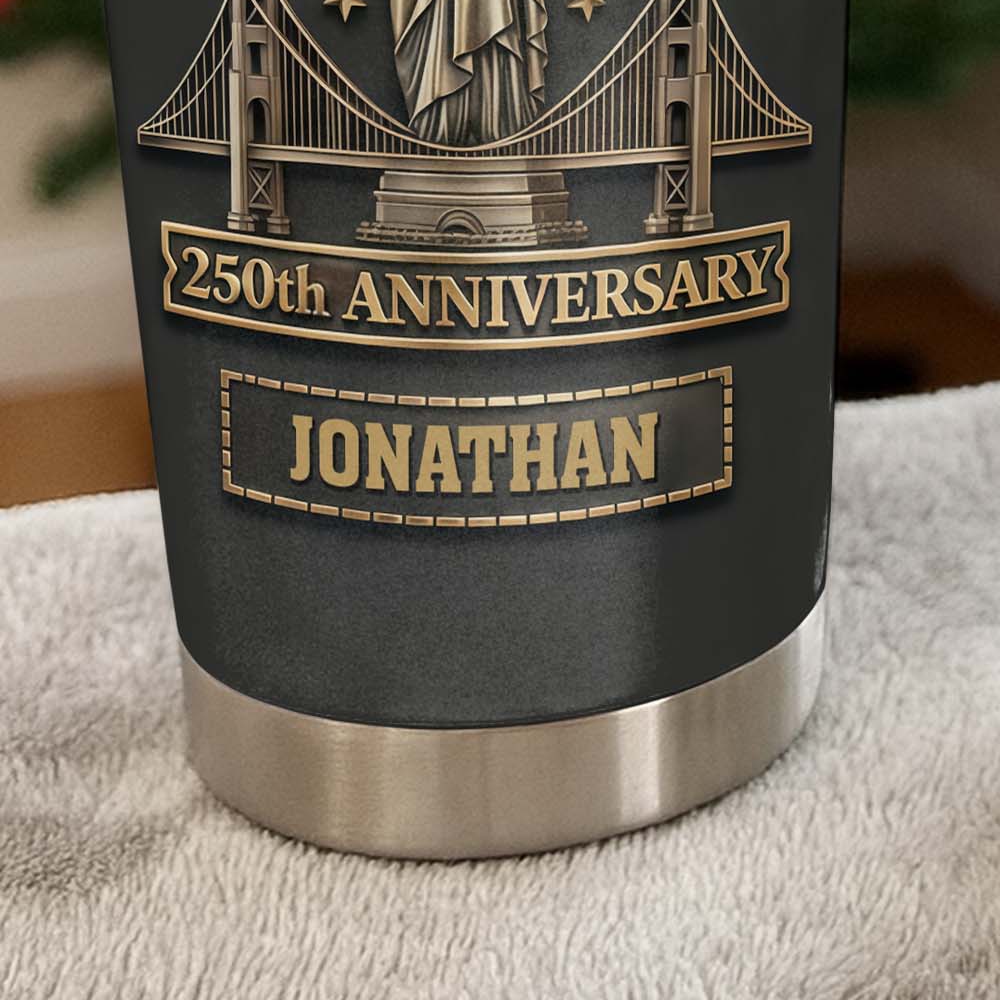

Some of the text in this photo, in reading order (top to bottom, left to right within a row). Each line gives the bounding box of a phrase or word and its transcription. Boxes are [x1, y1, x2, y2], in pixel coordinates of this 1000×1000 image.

[181, 245, 778, 329] 250th ANNIVERSARY
[290, 412, 660, 494] JONATHAN
